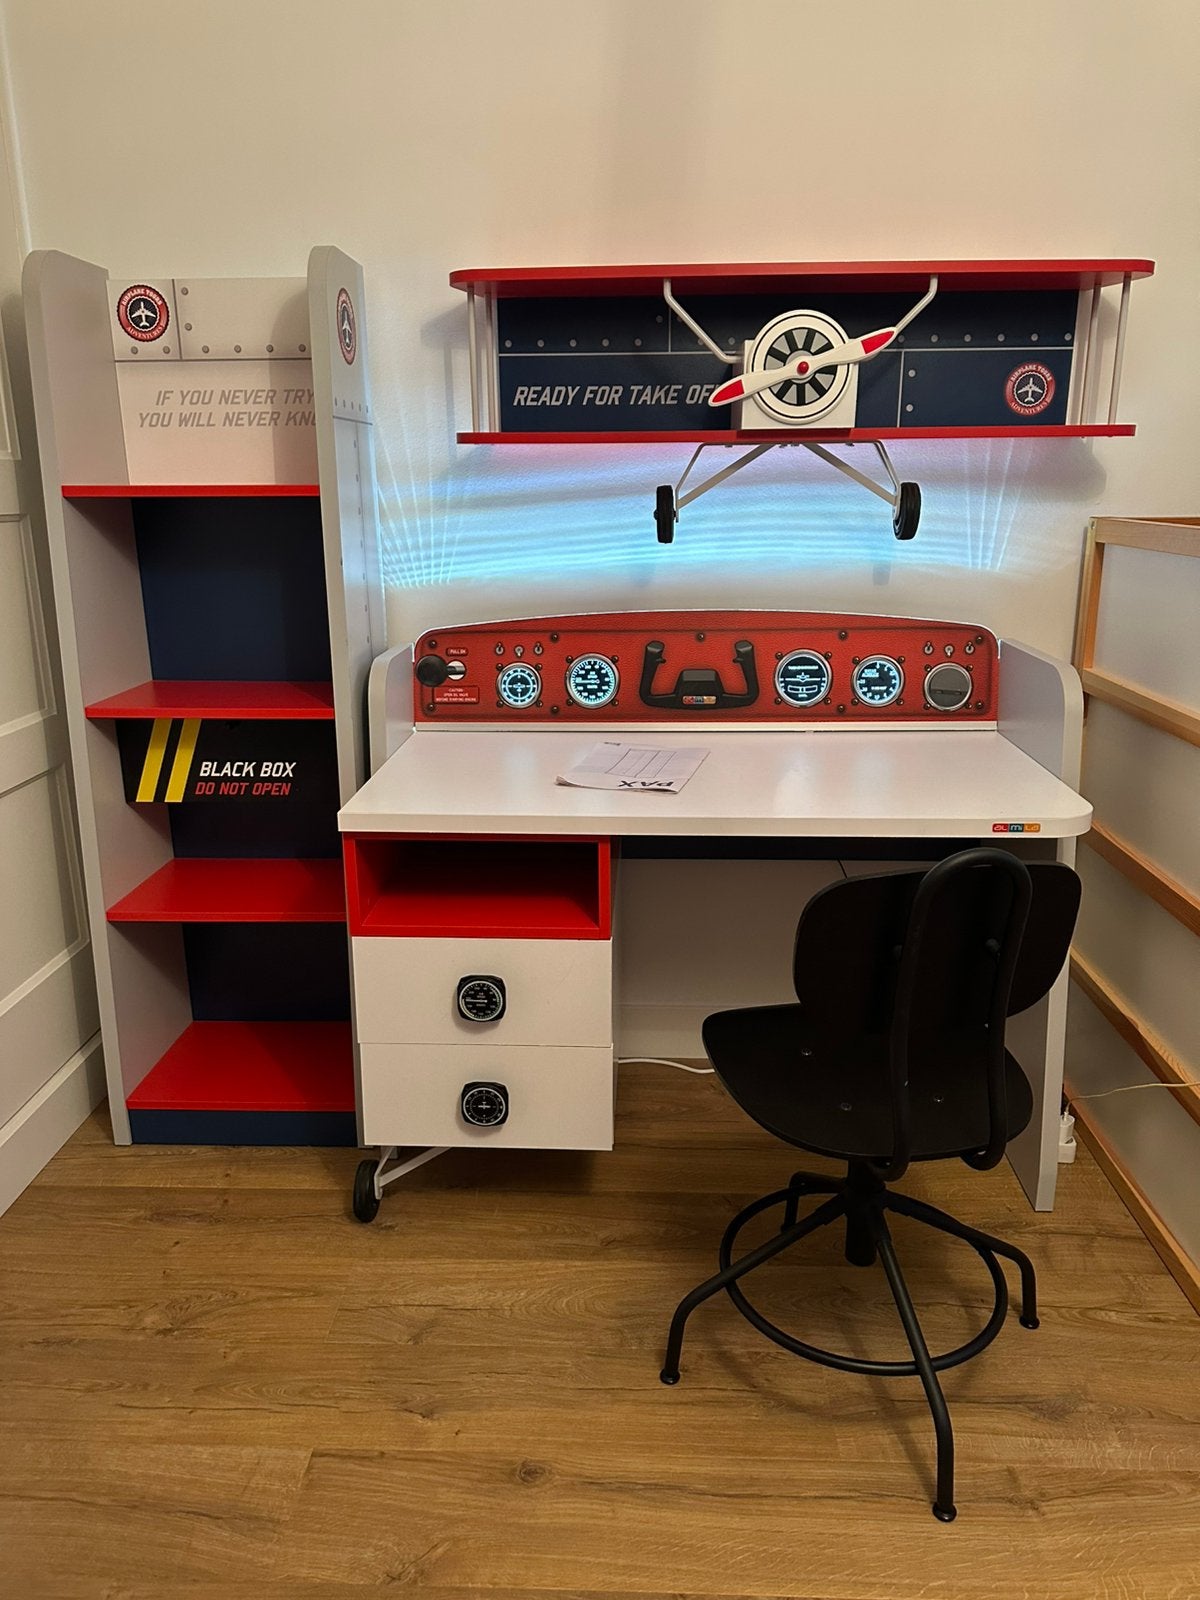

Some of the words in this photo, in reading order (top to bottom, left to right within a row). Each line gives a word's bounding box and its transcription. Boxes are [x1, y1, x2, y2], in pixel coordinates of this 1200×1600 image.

[155, 390, 174, 406] IF
[180, 390, 215, 405] YOU
[218, 389, 277, 405] NEVER
[283, 388, 315, 405] TRY
[513, 385, 580, 406] READY
[582, 385, 623, 405] FOR
[629, 385, 683, 405] TAKE
[686, 384, 720, 404] OF
[138, 412, 173, 428] YOU
[177, 412, 216, 427] WILL
[222, 411, 280, 426] NEVER
[200, 761, 257, 777] BLACK
[260, 762, 297, 778] BOX
[195, 782, 216, 795] DO
[219, 782, 250, 795] NOT
[252, 782, 292, 796] OPEN
[617, 780, 674, 788] PAX
